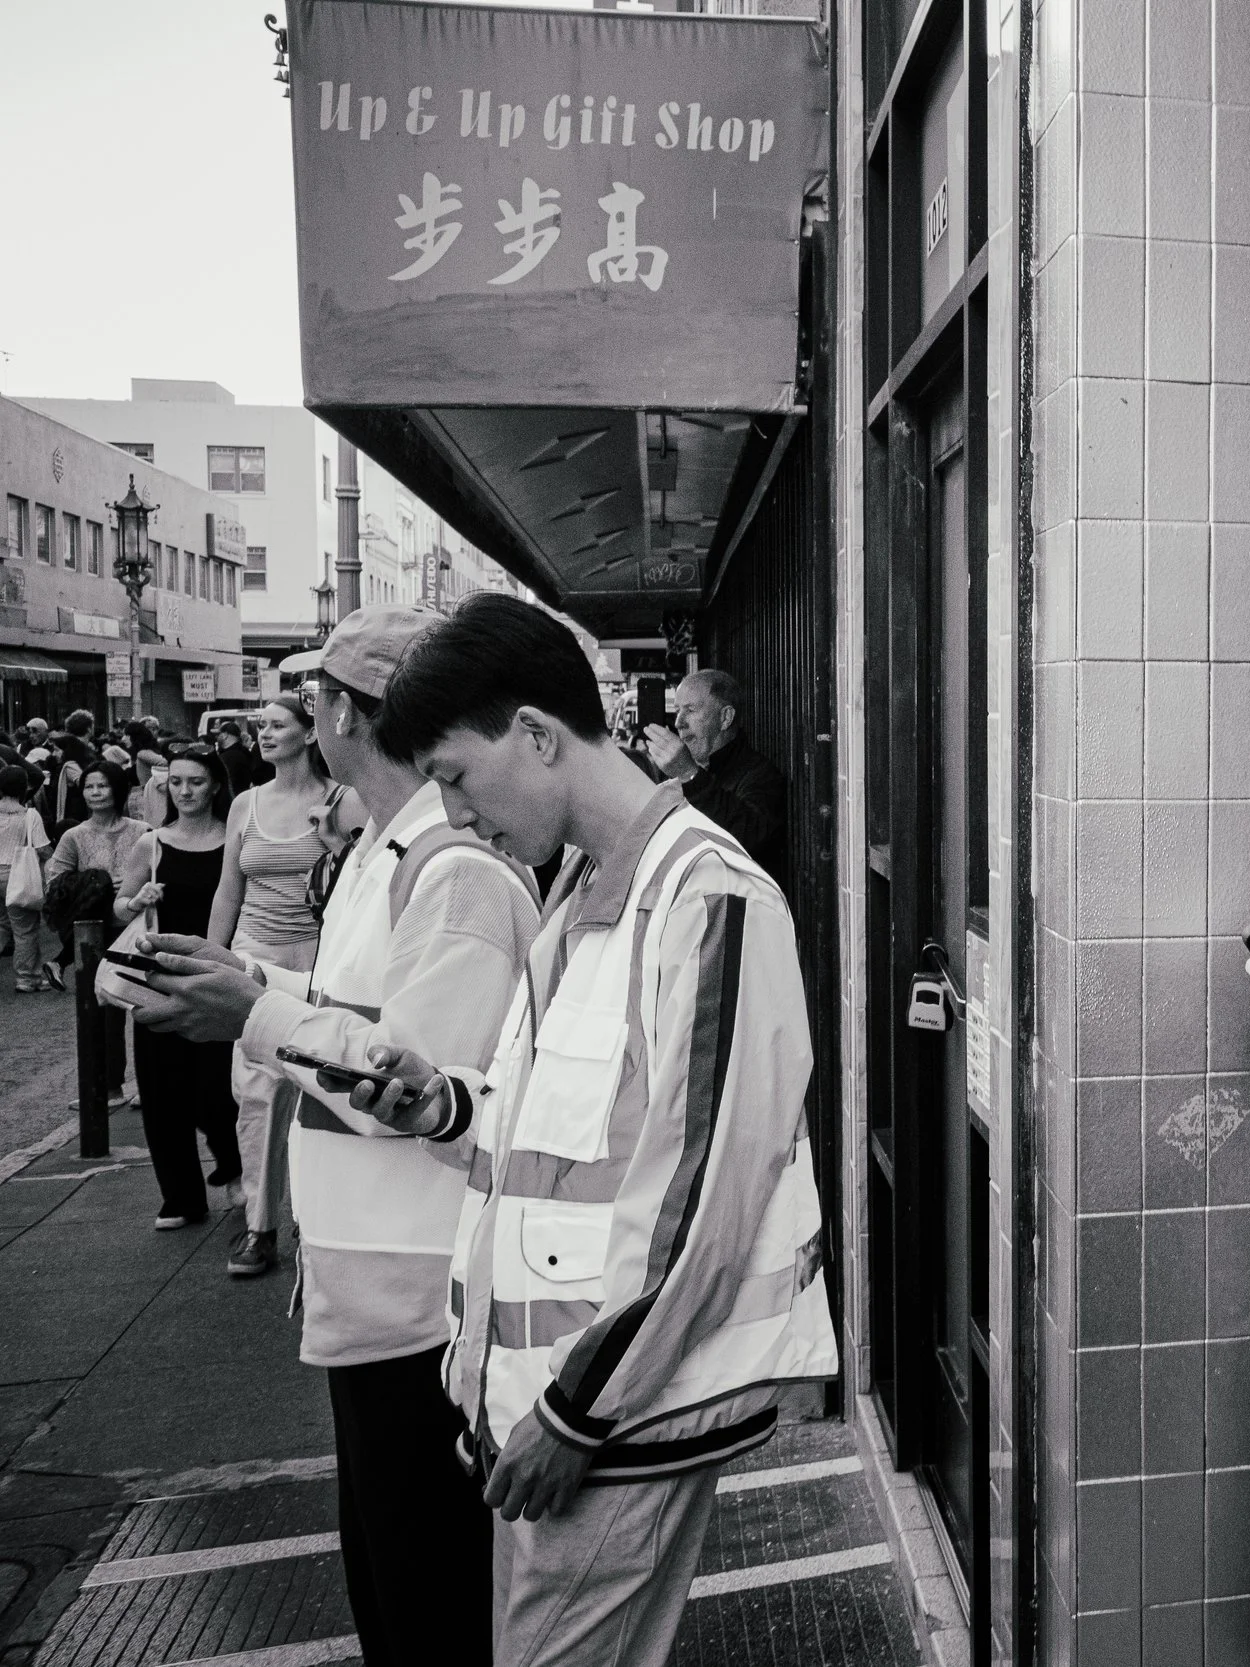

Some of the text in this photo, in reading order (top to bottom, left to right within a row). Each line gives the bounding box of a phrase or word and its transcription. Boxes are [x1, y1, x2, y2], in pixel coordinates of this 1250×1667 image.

[318, 81, 775, 162] Up & Up Gift Shop
[928, 183, 947, 253] 1012
[426, 556, 437, 612] SHISEIDO
[190, 682, 208, 691] MUST
